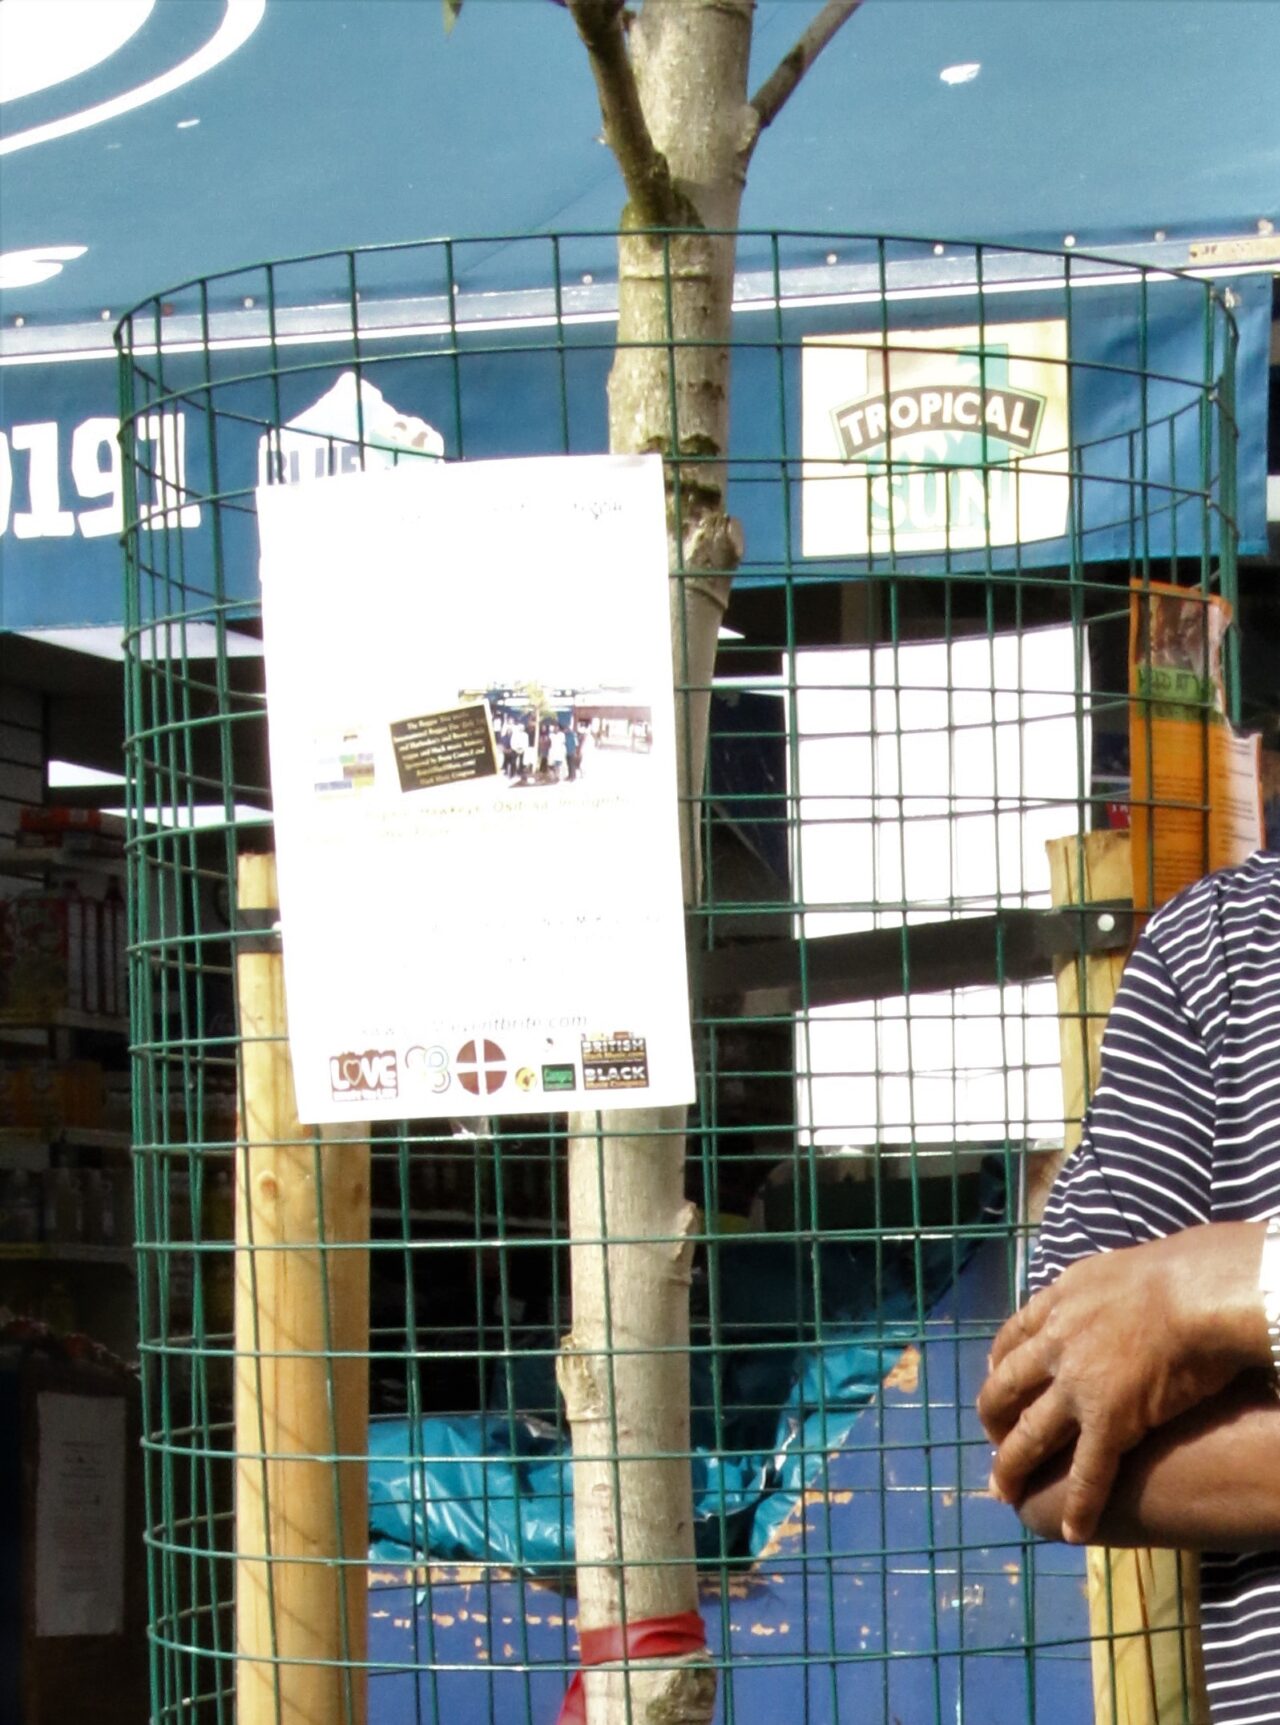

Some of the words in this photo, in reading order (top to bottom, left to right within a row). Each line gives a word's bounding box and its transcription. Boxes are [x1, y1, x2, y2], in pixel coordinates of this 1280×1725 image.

[839, 391, 1030, 448] TROPICAL
[0, 412, 201, 539] 191
[870, 468, 1006, 532] SUN
[330, 1054, 397, 1091] LOVE
[584, 1066, 646, 1082] BLACK
